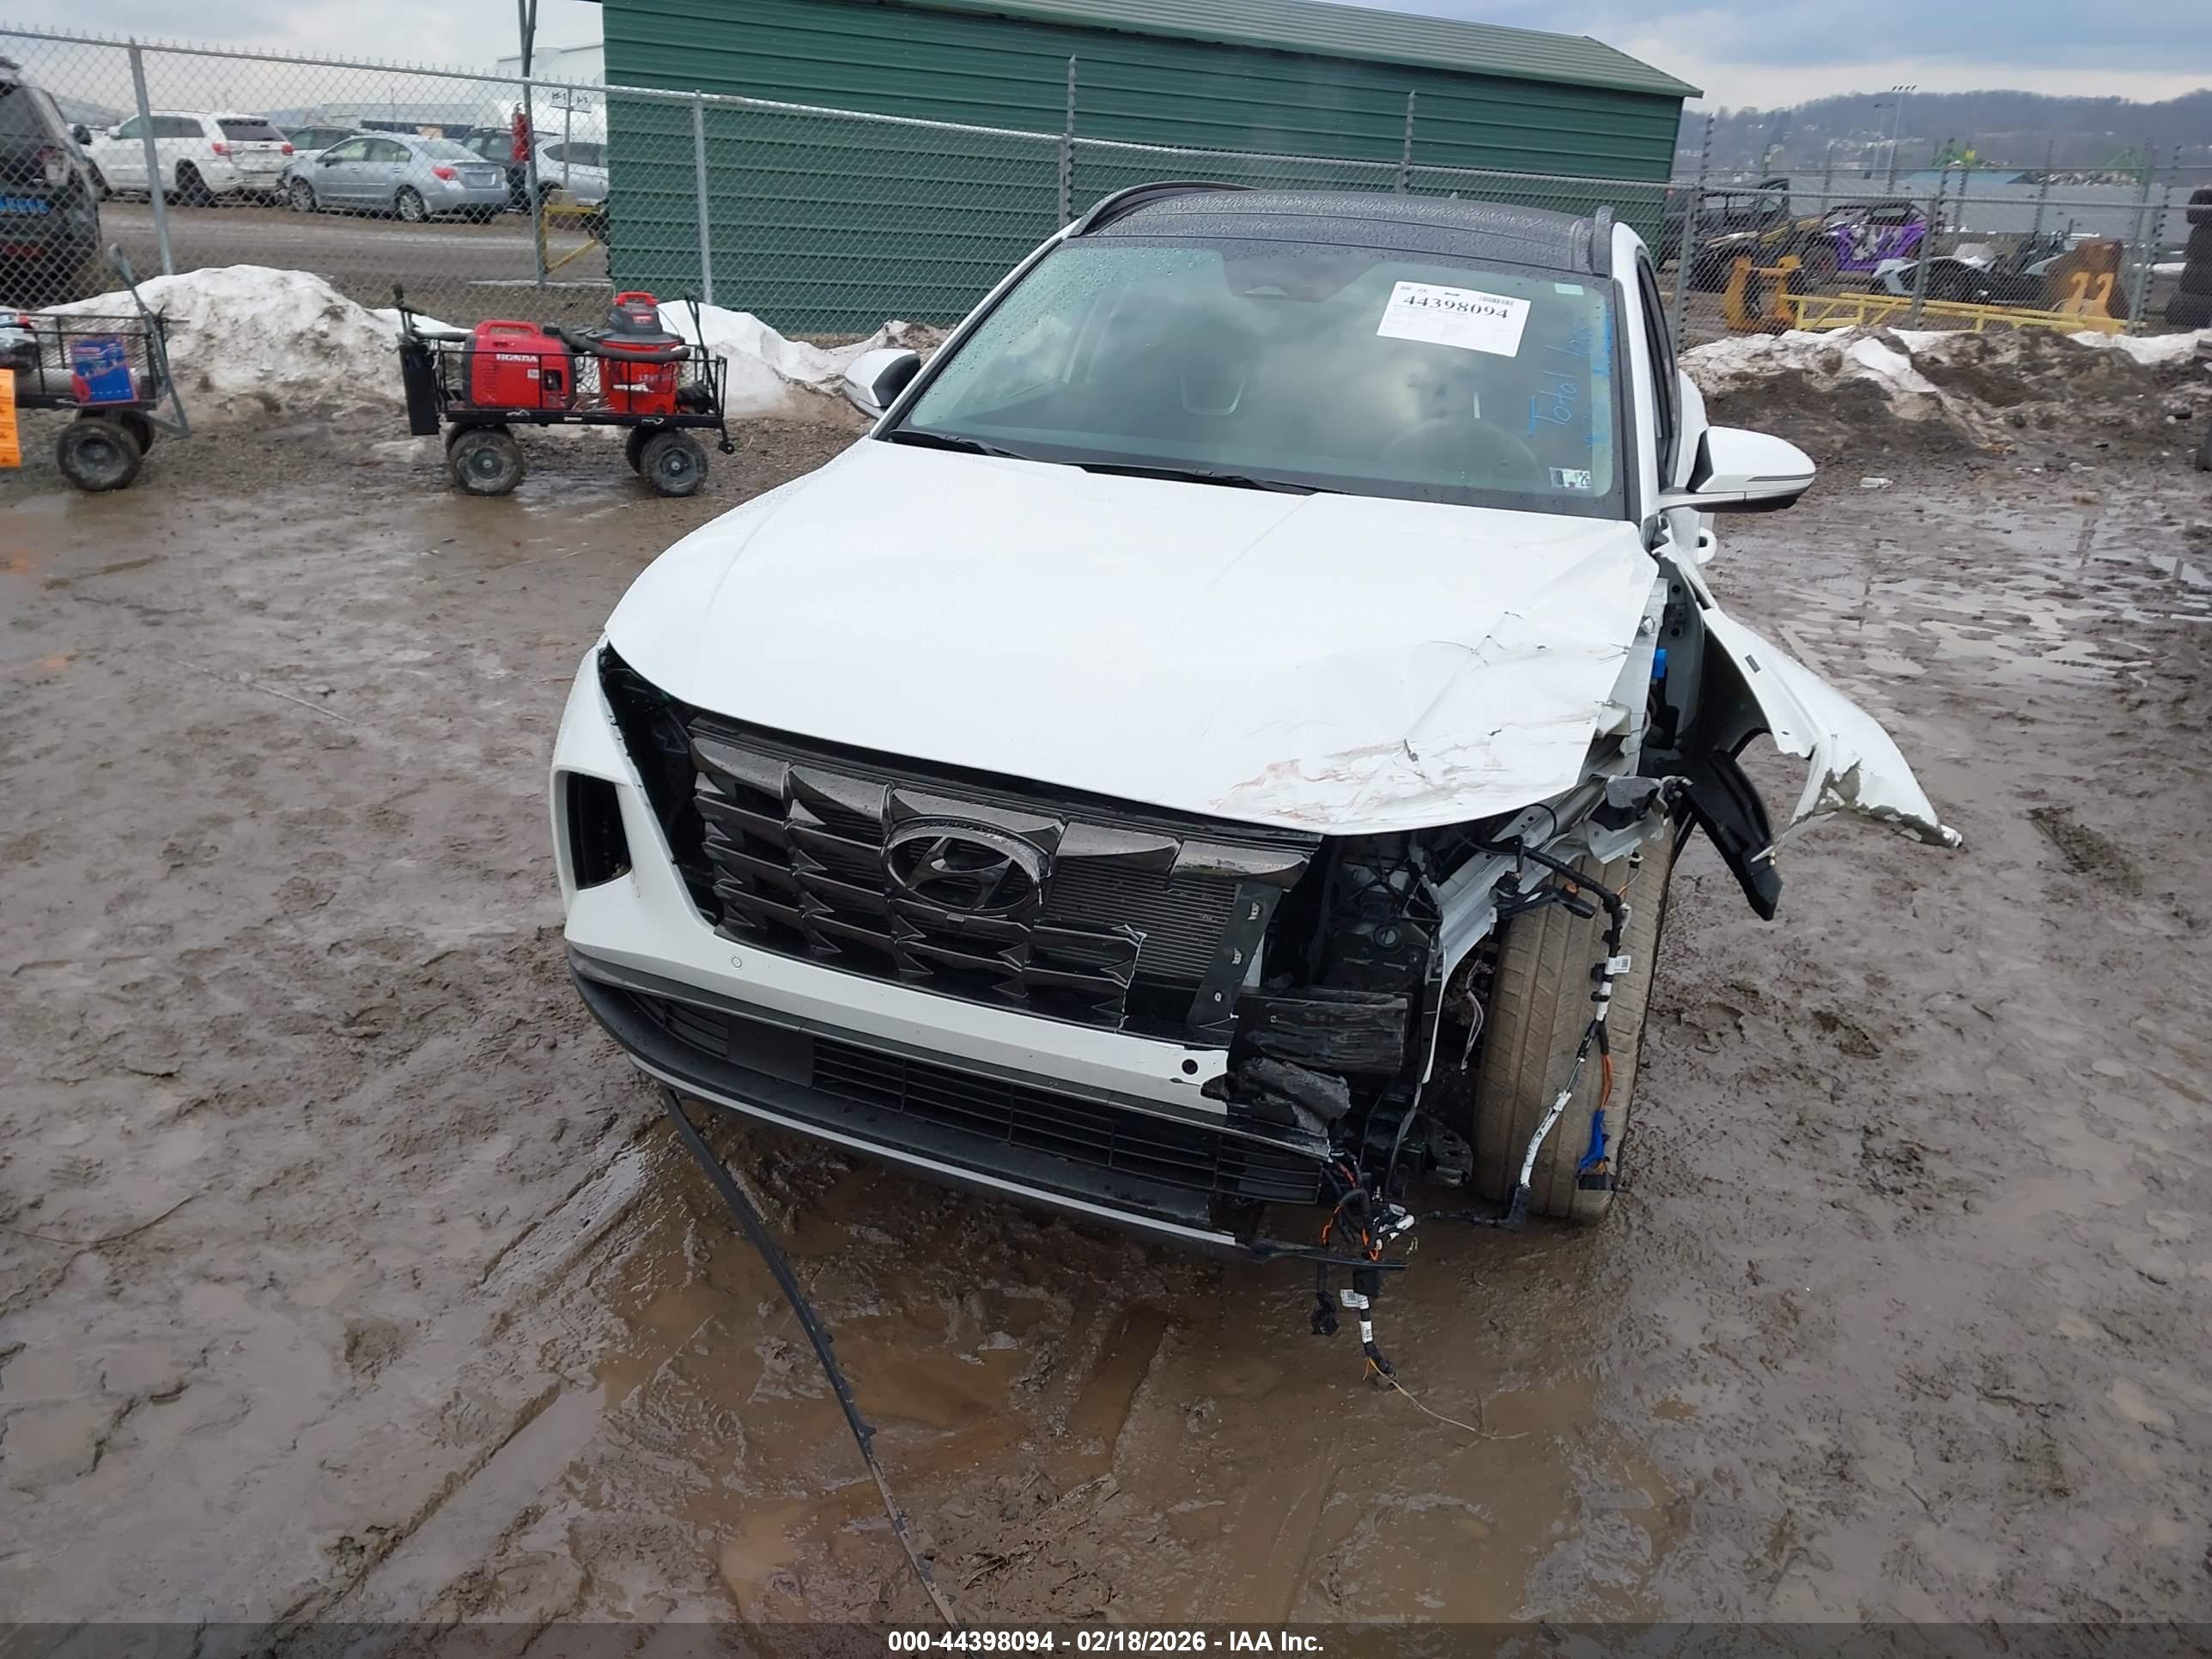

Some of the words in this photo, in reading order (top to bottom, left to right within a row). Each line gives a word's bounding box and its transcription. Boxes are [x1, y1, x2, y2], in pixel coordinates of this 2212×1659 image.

[1402, 295, 1509, 319] 44398094
[495, 353, 539, 363] HONDA
[1528, 369, 1578, 436] Total
